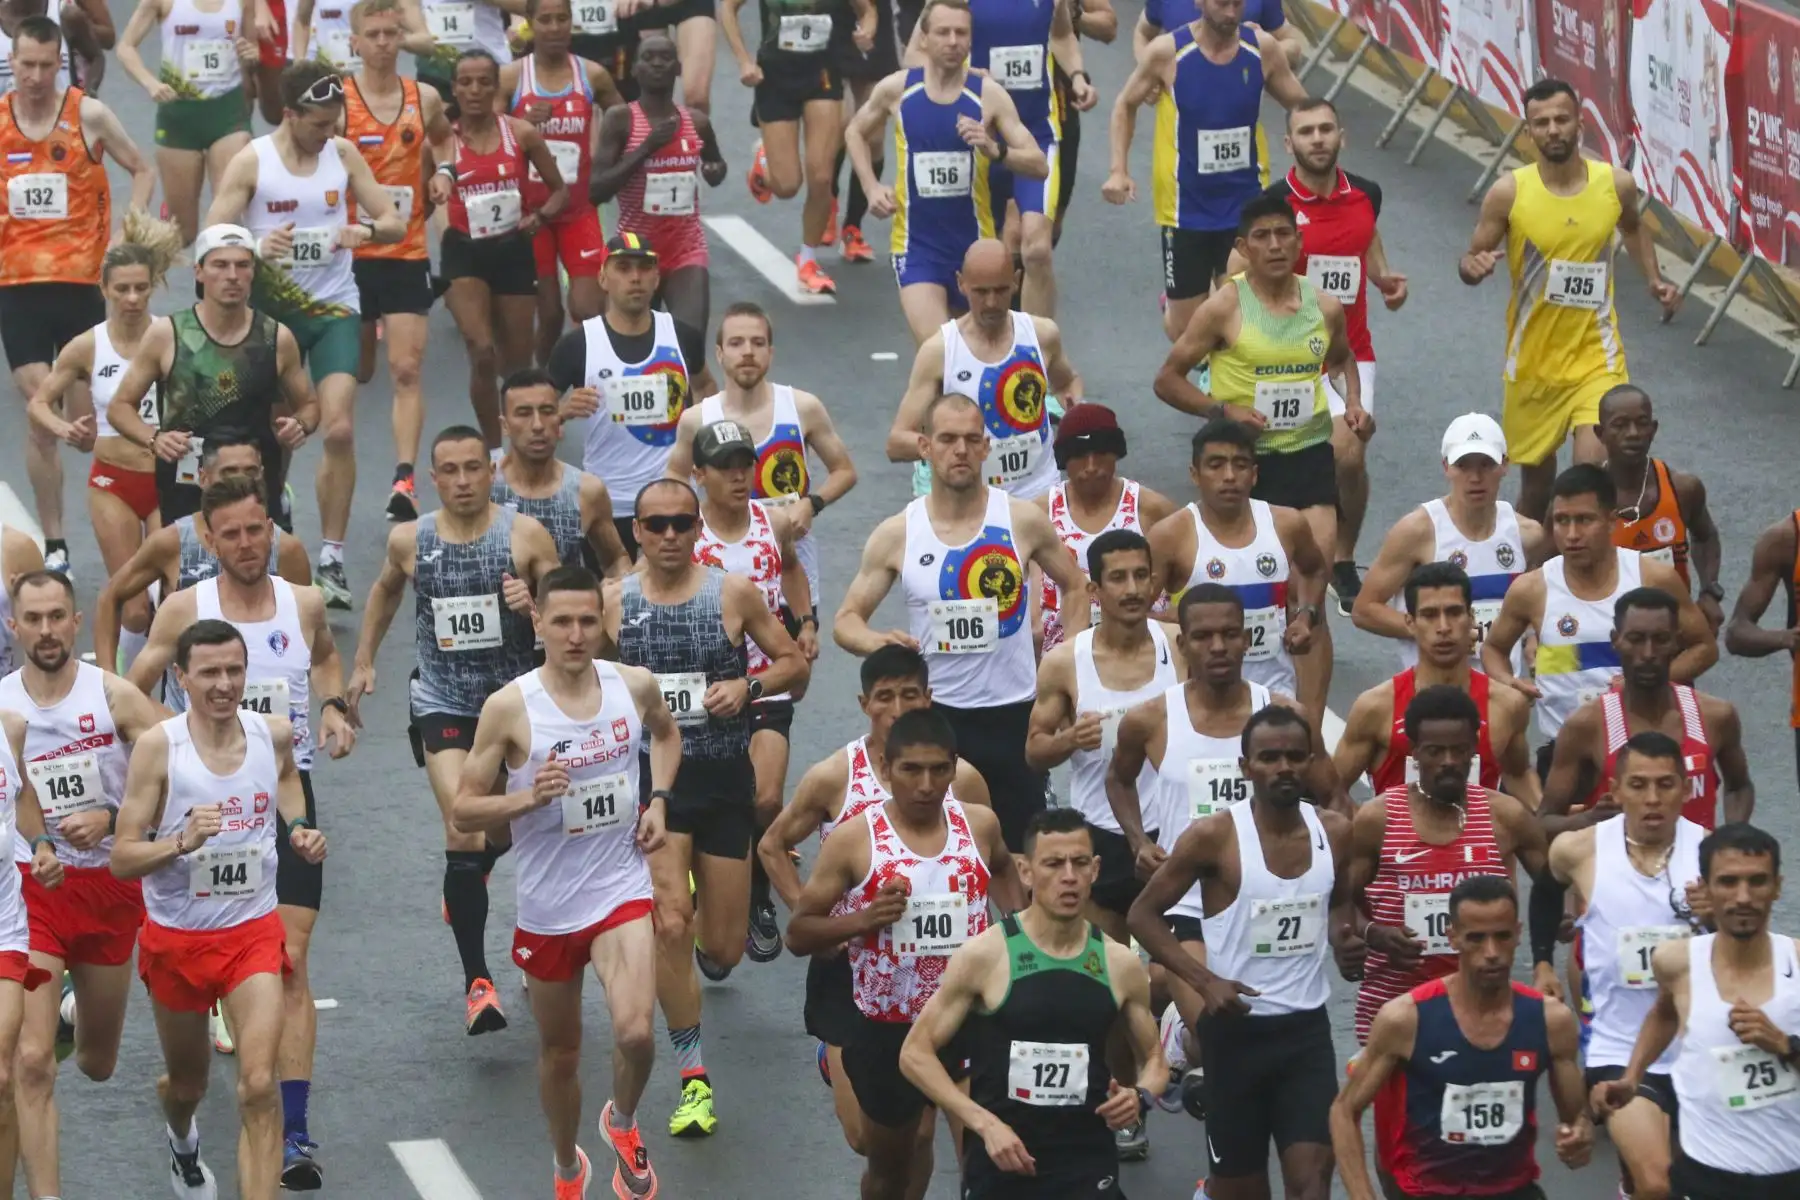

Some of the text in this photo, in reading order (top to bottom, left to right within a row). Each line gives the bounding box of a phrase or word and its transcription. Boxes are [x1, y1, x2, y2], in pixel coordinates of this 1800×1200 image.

[442, 16, 458, 32] 14
[580, 6, 606, 22] 120
[204, 53, 219, 69] 15
[1004, 60, 1032, 77] 154
[1213, 141, 1240, 160] 155
[928, 167, 958, 184] 156
[24, 188, 53, 206] 132
[671, 186, 677, 203] 1
[491, 205, 502, 222] 2
[293, 242, 321, 261] 126
[1165, 250, 1175, 288] SWE
[1321, 271, 1351, 290] 136
[1564, 276, 1594, 296] 135
[1255, 364, 1320, 376] ECUADOR
[621, 390, 655, 411] 108
[1272, 398, 1300, 418] 113
[998, 450, 1028, 472] 107
[448, 612, 485, 635] 149
[945, 616, 984, 640] 106
[45, 736, 105, 761] POLSKA
[45, 774, 85, 800] 143
[1208, 778, 1247, 802] 145
[582, 793, 615, 820] 141
[210, 863, 248, 886] 144
[912, 913, 952, 939] 140
[1277, 915, 1302, 941] 27
[1032, 1062, 1070, 1088] 127
[1743, 1059, 1778, 1090] 25
[1461, 1102, 1505, 1130] 158
